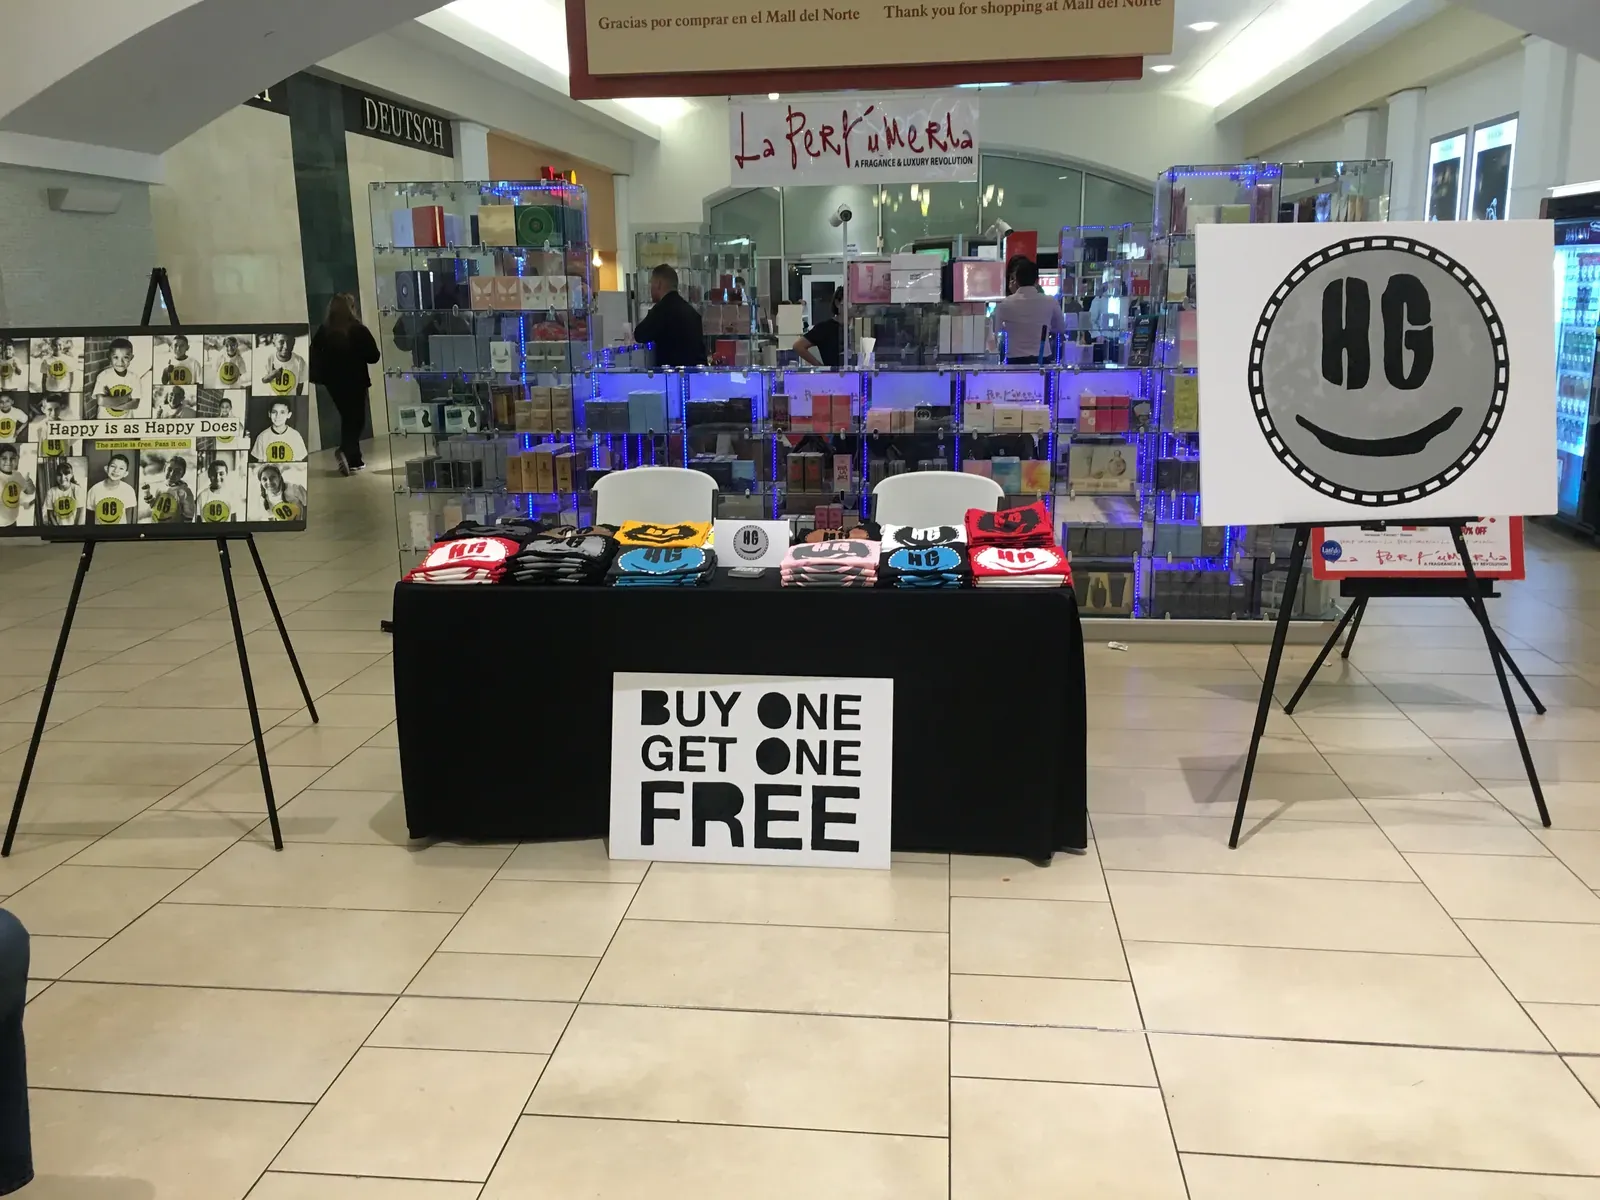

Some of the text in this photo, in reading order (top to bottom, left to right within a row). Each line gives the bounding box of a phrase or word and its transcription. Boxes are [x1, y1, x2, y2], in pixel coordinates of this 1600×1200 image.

[598, 8, 860, 30] Gracias por comprar en el Mall del Norte
[884, 5, 929, 19] Thank
[931, 5, 956, 19] you
[958, 3, 978, 15] for
[981, 1, 1042, 17] shopping
[1045, 1, 1058, 11] at
[1062, 0, 1093, 10] Mall
[364, 97, 445, 149] DEUTSCH
[734, 111, 775, 170] La
[854, 156, 973, 168] A FRAGANCE & LUXURY REVOLUTION
[1322, 273, 1434, 391] HG
[49, 420, 237, 437] Happy is as Happy Does
[743, 530, 759, 545] HG
[1475, 526, 1488, 536] OFF
[907, 550, 940, 567] HG
[640, 689, 862, 731] BUY ONE
[641, 734, 861, 777] GET ONE
[640, 780, 860, 853] FREE
